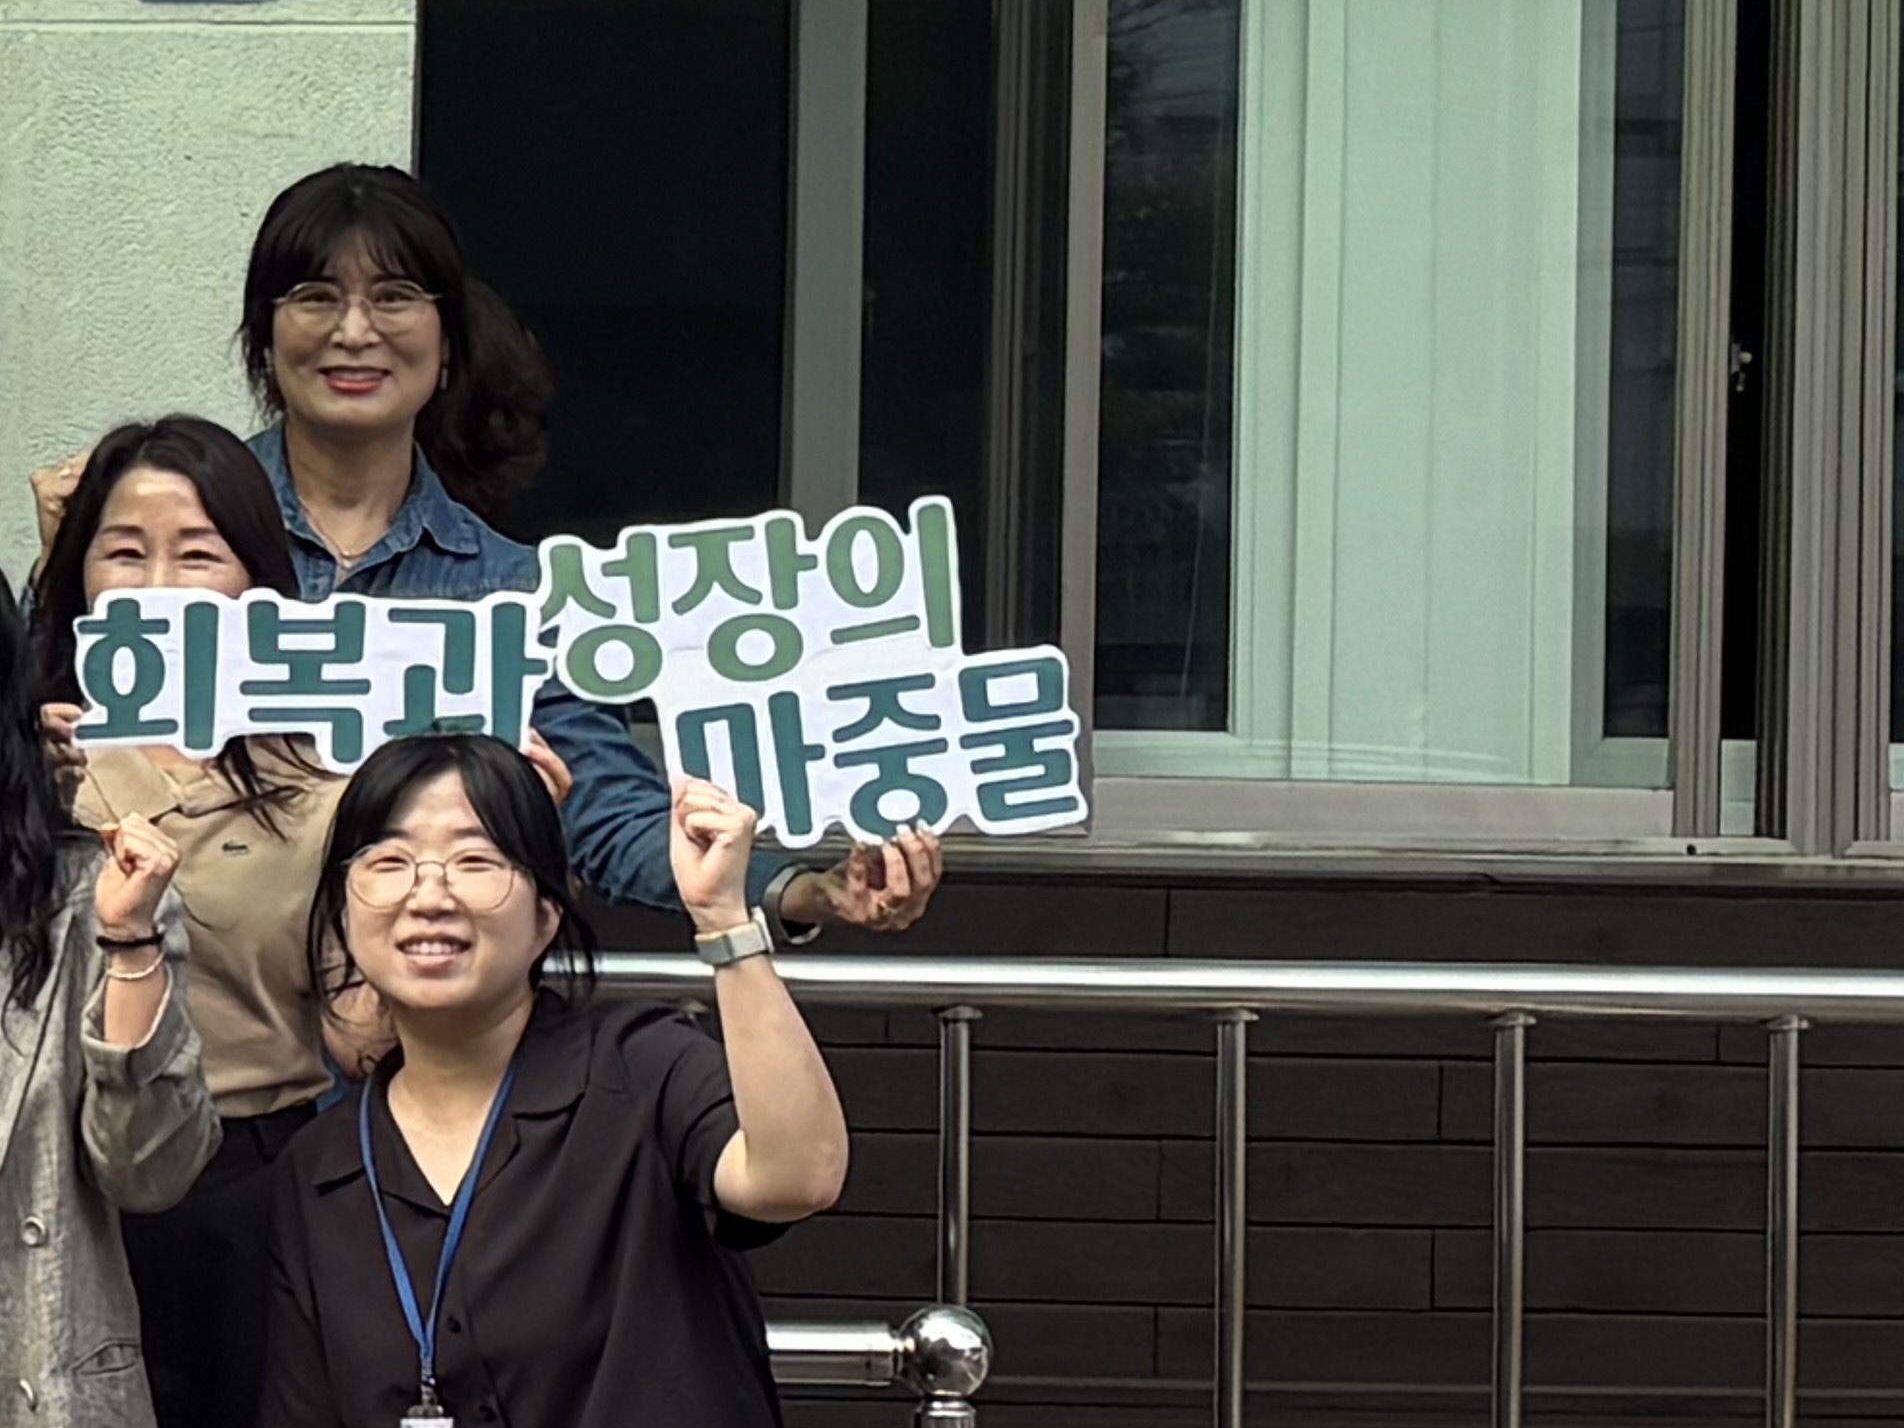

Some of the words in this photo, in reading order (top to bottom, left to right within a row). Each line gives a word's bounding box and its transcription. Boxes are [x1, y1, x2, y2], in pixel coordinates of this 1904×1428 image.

[76, 598, 547, 763] 회복과
[540, 497, 954, 697] 성장의
[676, 656, 1079, 836] 마중물
